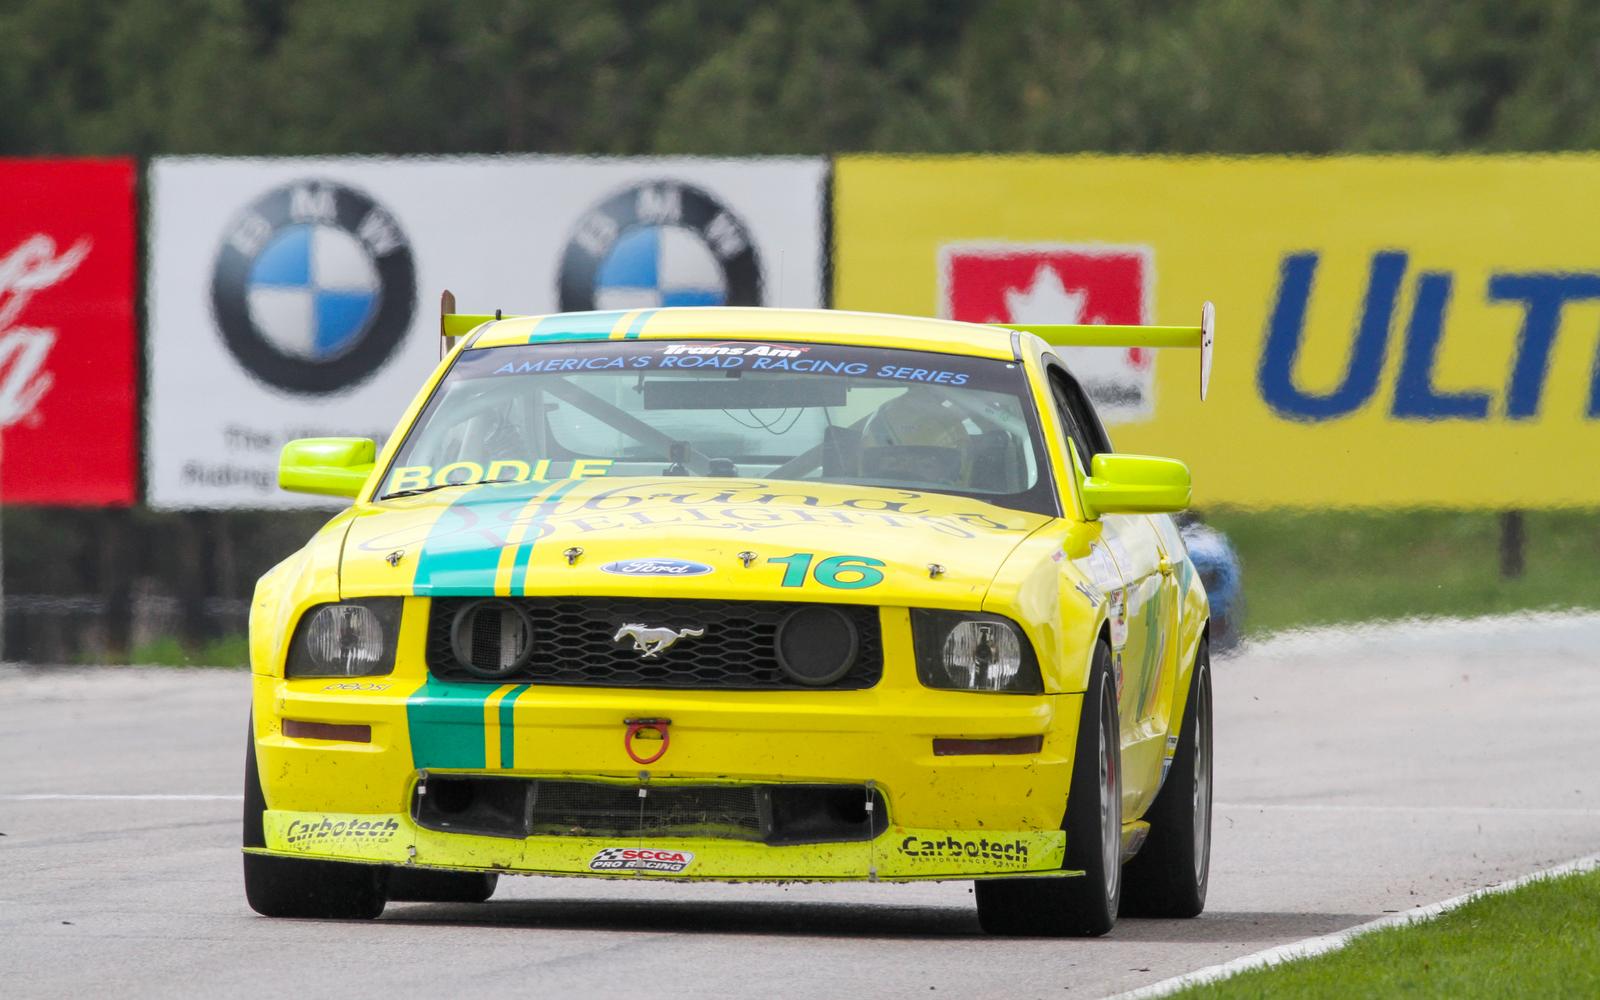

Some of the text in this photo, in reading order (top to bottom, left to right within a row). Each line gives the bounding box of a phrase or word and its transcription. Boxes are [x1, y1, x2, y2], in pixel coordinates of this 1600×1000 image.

[228, 188, 401, 257] BMW
[574, 184, 747, 259] BMW
[1257, 249, 1600, 422] ULT
[663, 344, 803, 358] Trans Am
[492, 355, 970, 386] AMERICA'S ROAD RACING SERIES
[622, 560, 690, 573] Ford
[766, 552, 887, 590] 16
[321, 682, 394, 693] pepsi
[286, 817, 400, 843] Carbotech
[623, 849, 686, 862] SCCA
[902, 836, 1028, 864] Carbotech
